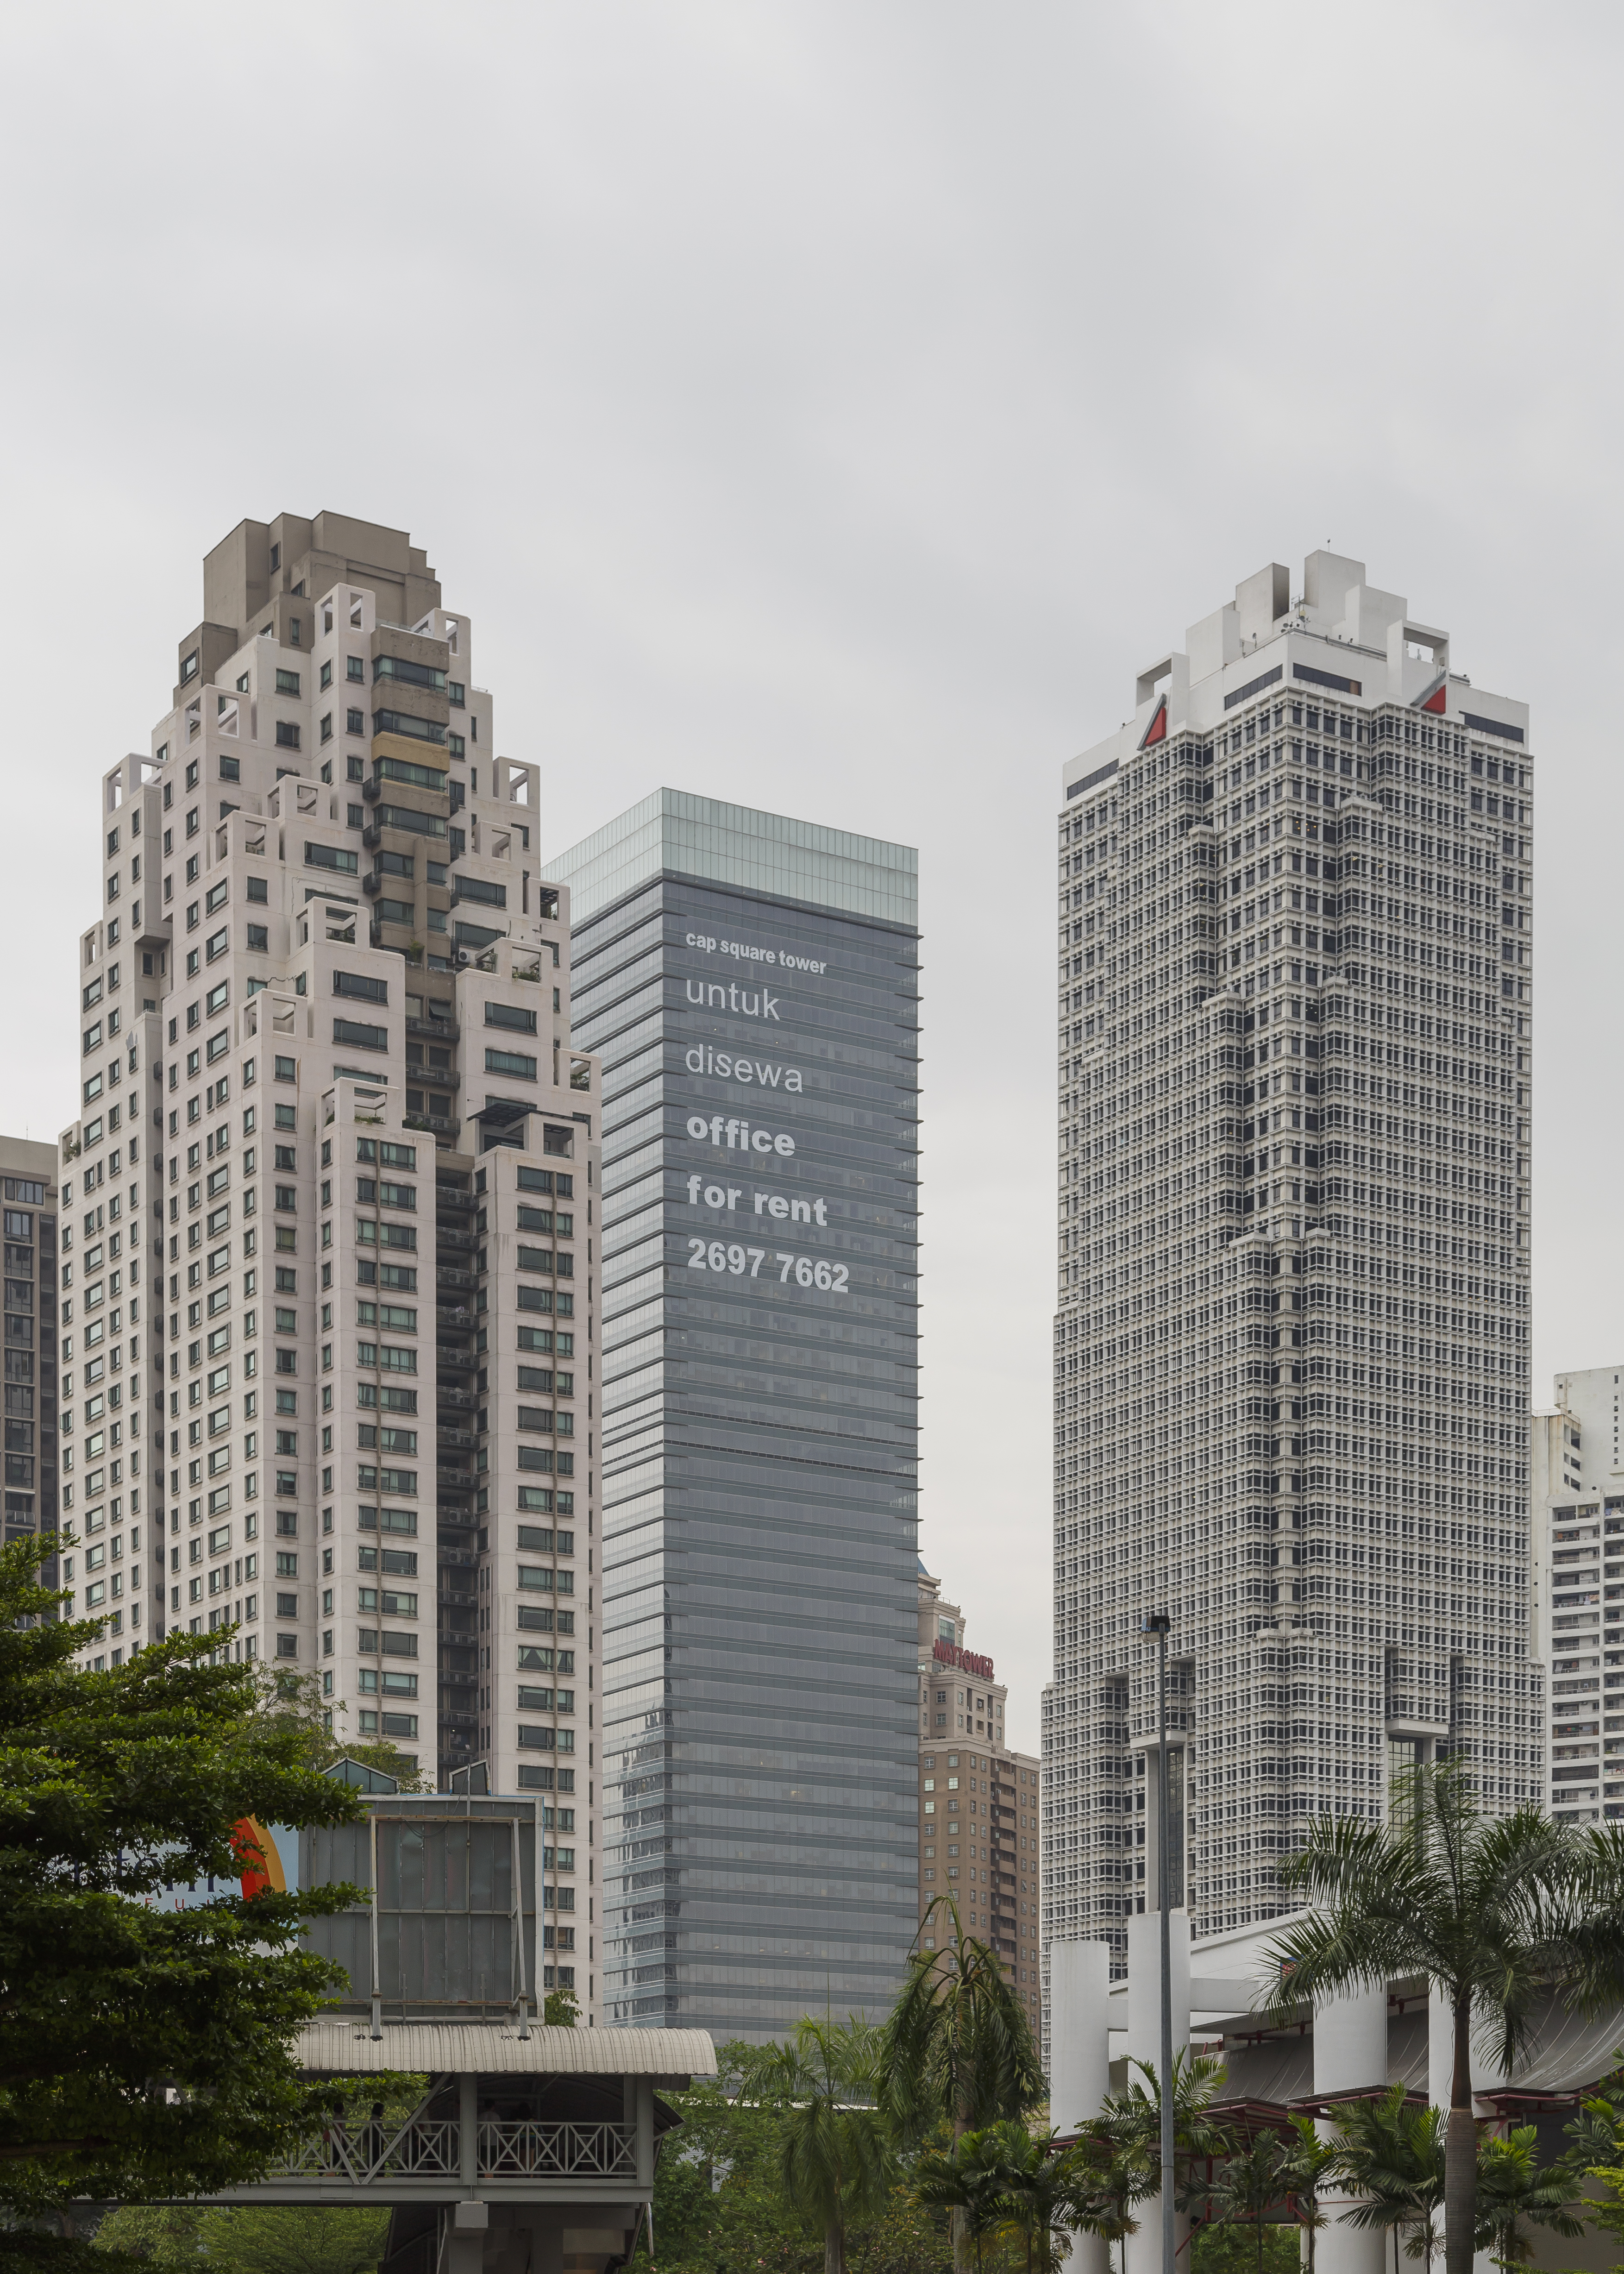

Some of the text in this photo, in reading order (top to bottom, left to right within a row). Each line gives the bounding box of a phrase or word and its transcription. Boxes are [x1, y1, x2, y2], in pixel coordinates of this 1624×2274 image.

[686, 933, 828, 974] cap square tower
[686, 978, 781, 1020] untuk
[685, 1043, 803, 1093] disewa
[687, 1116, 796, 1156] office
[687, 1175, 828, 1226] for rent
[688, 1238, 850, 1294] 2697 7662
[934, 1639, 994, 1679] MAYTOWER
